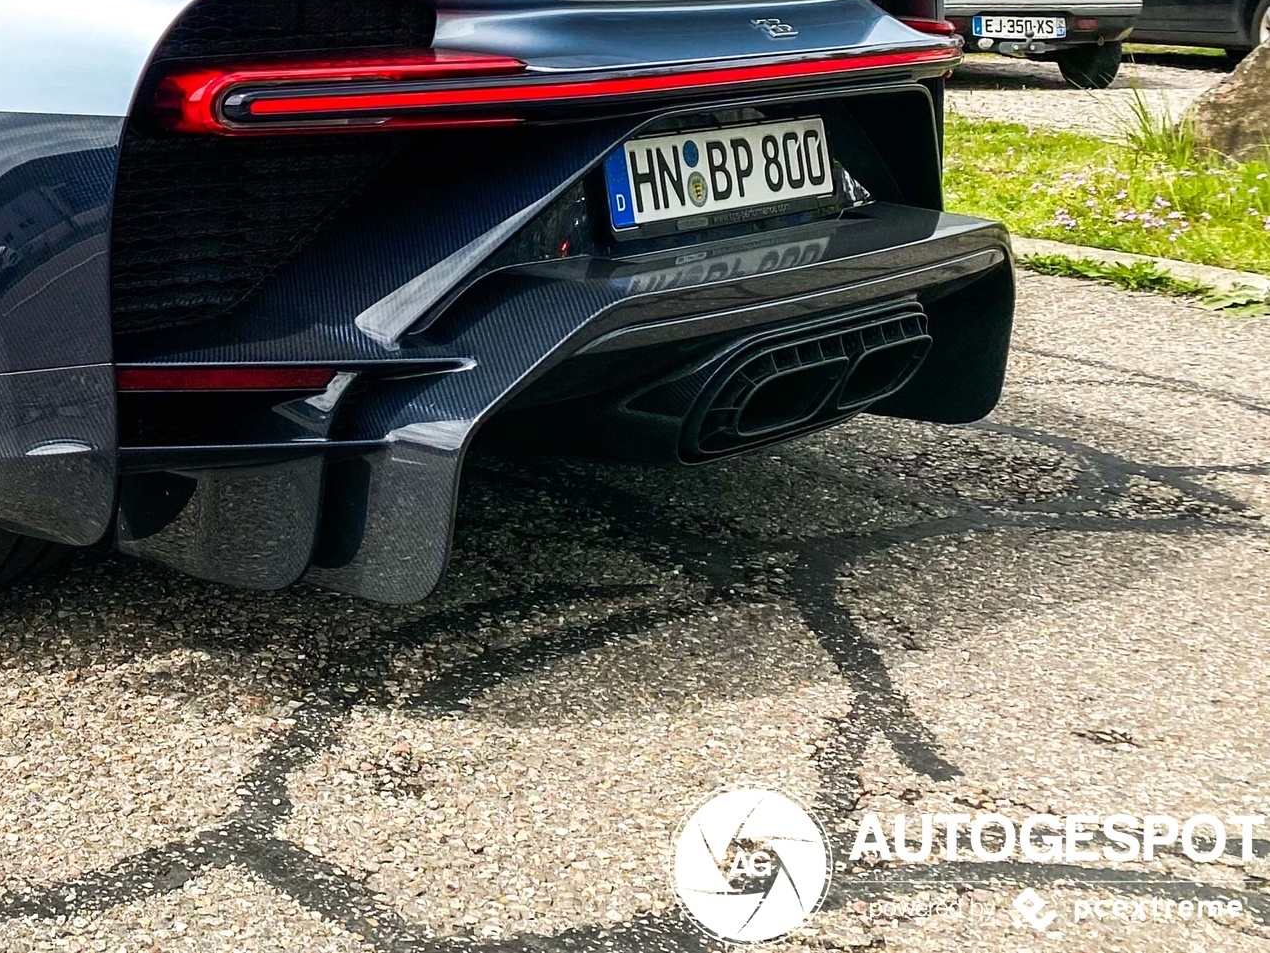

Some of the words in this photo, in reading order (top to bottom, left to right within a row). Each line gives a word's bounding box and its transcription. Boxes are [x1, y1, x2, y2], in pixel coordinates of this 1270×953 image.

[629, 145, 686, 212] HN
[706, 137, 753, 201] BP
[761, 129, 826, 192] 800
[616, 194, 626, 212] D
